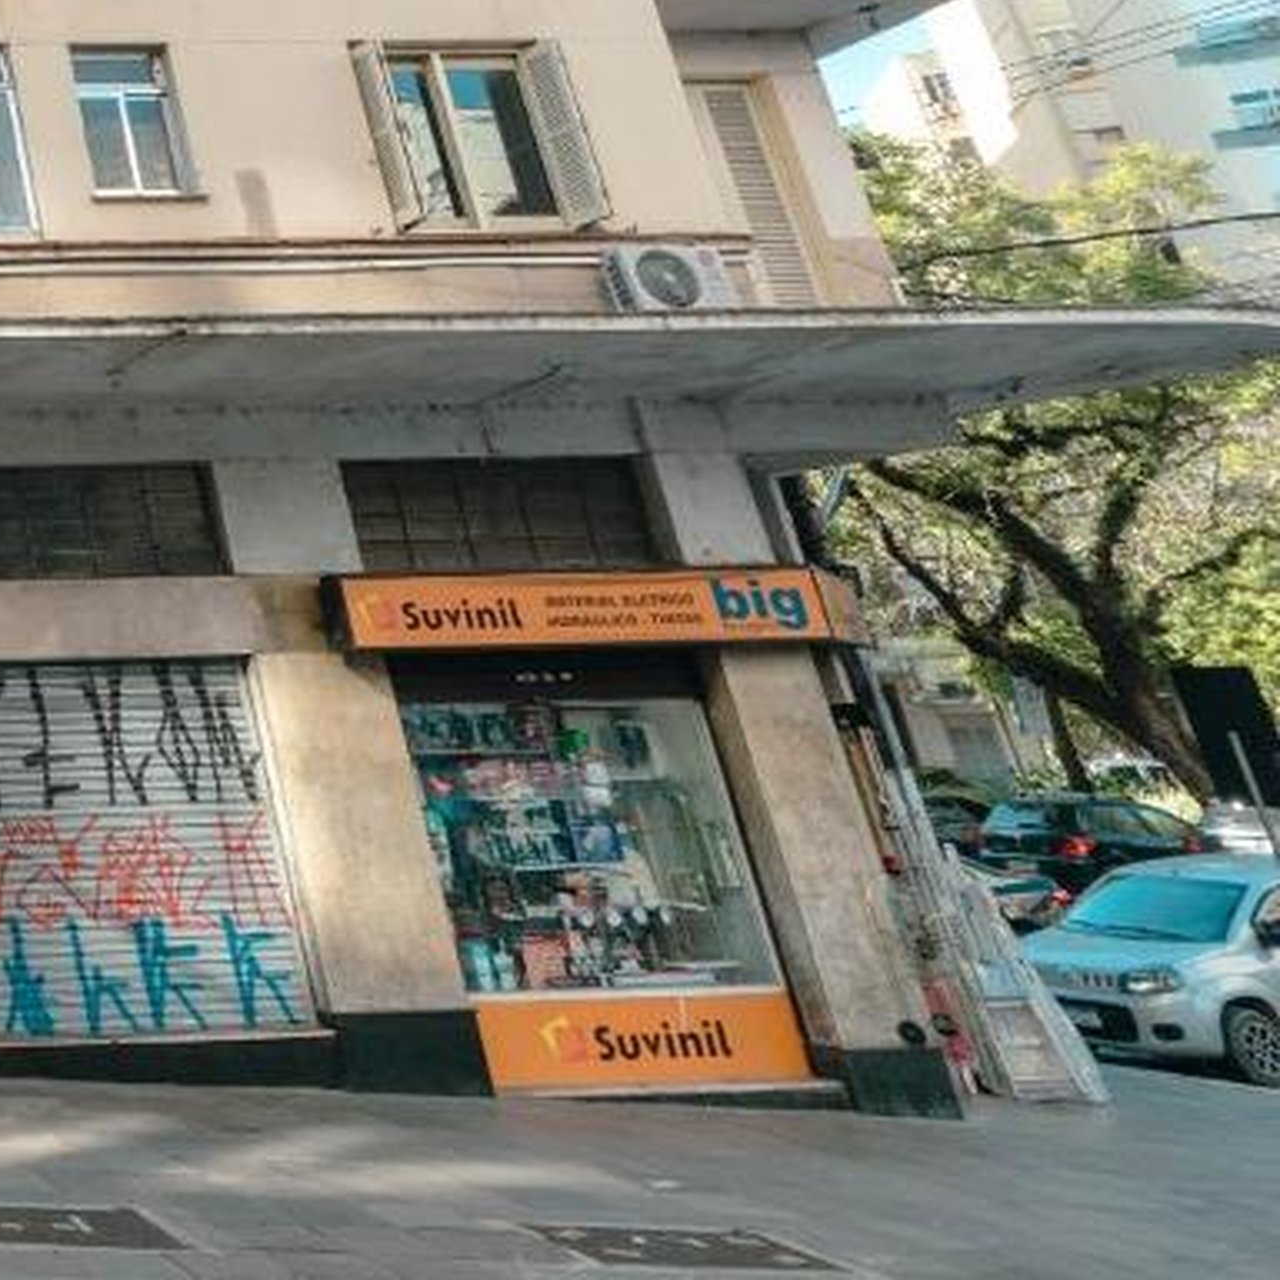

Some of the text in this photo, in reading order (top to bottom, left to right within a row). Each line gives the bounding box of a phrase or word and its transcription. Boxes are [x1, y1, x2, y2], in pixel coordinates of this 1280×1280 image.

[401, 598, 524, 631] Suvinil
[712, 576, 809, 631] big
[593, 1019, 733, 1062] Suvinil
